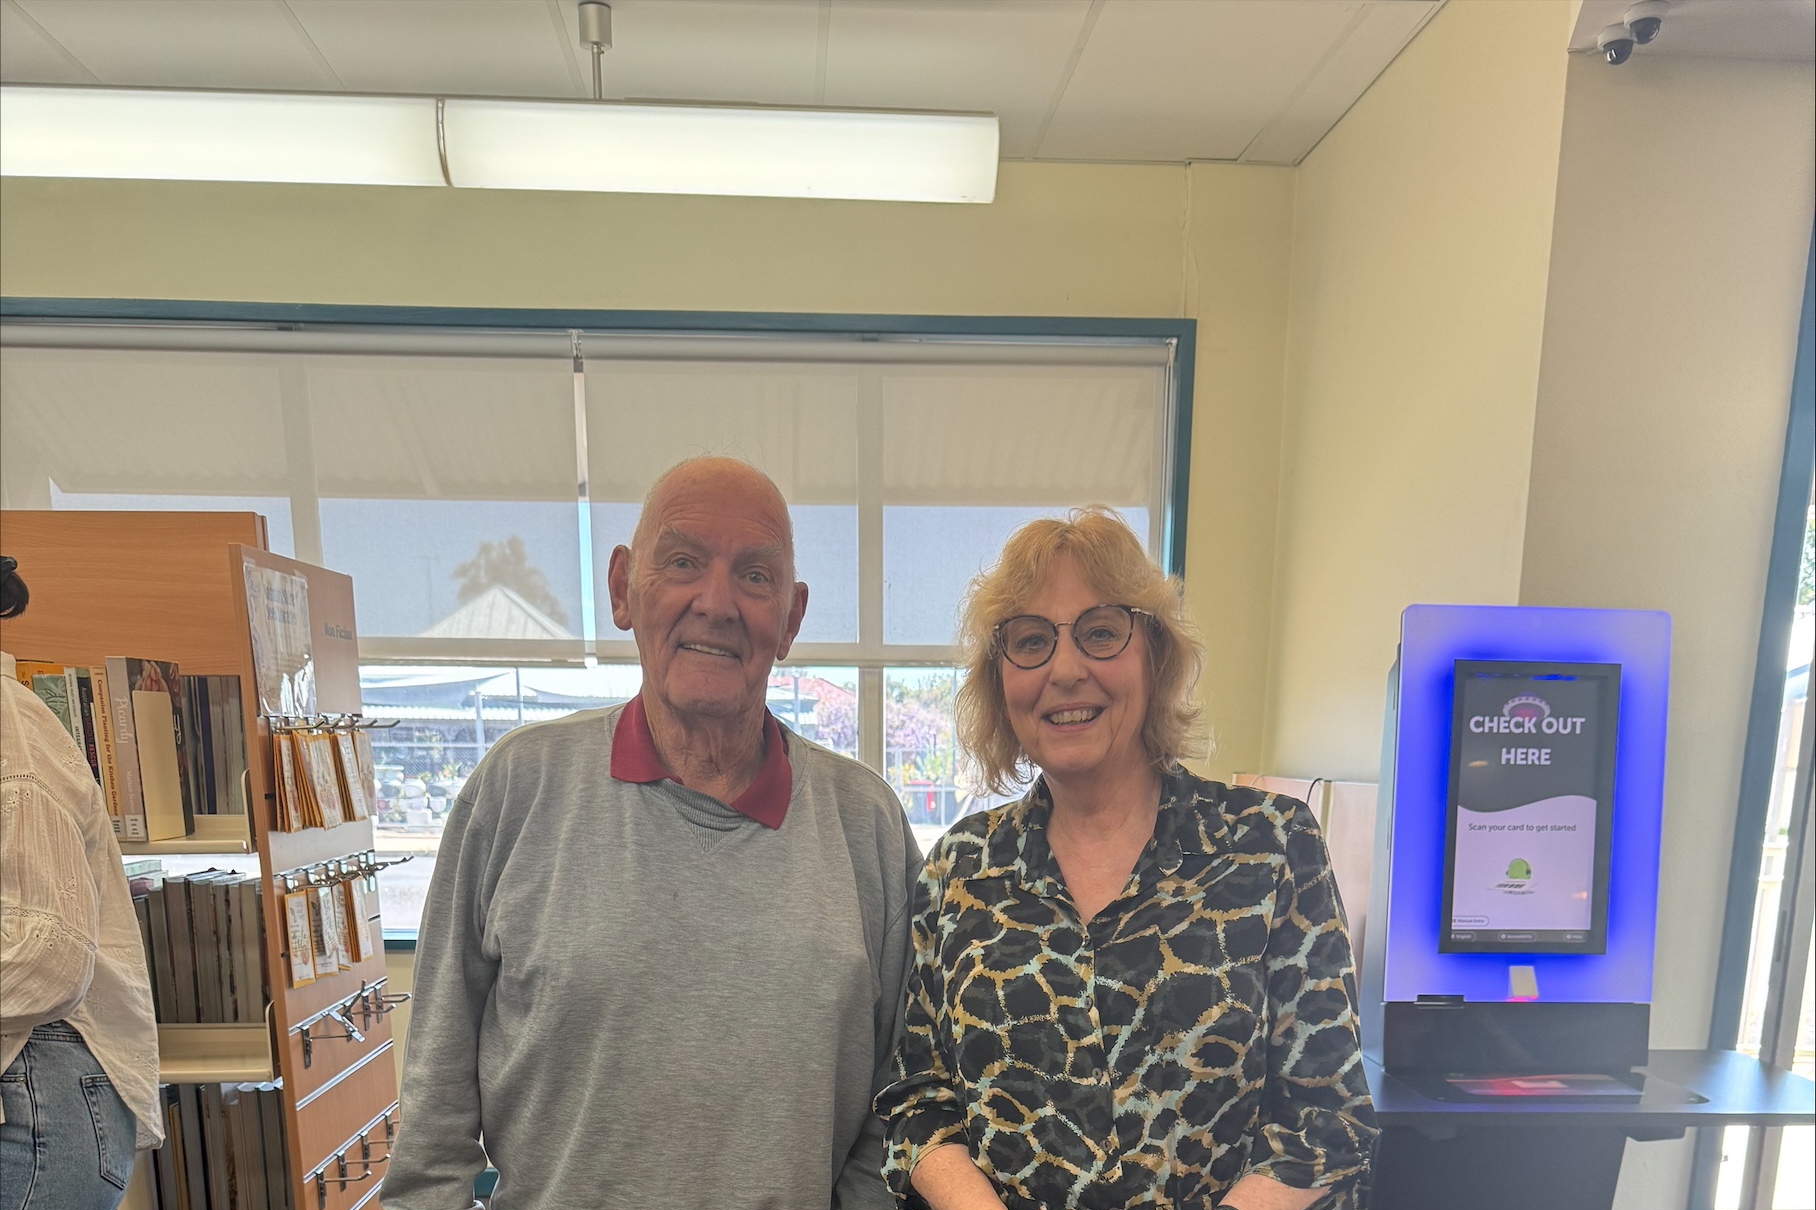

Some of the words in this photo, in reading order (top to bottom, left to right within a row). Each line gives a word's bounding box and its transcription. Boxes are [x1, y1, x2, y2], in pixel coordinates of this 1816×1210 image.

[97, 679, 106, 715] Companion
[81, 687, 89, 716] Australian
[88, 744, 97, 769] RESCUE
[115, 696, 133, 744] Picardy
[1469, 715, 1537, 734] CHECK
[1541, 717, 1586, 735] OUT
[1501, 747, 1552, 766] HERE
[1468, 823, 1487, 831] Scan
[1488, 824, 1506, 832] your
[1536, 824, 1549, 833] get
[1549, 824, 1577, 832] started
